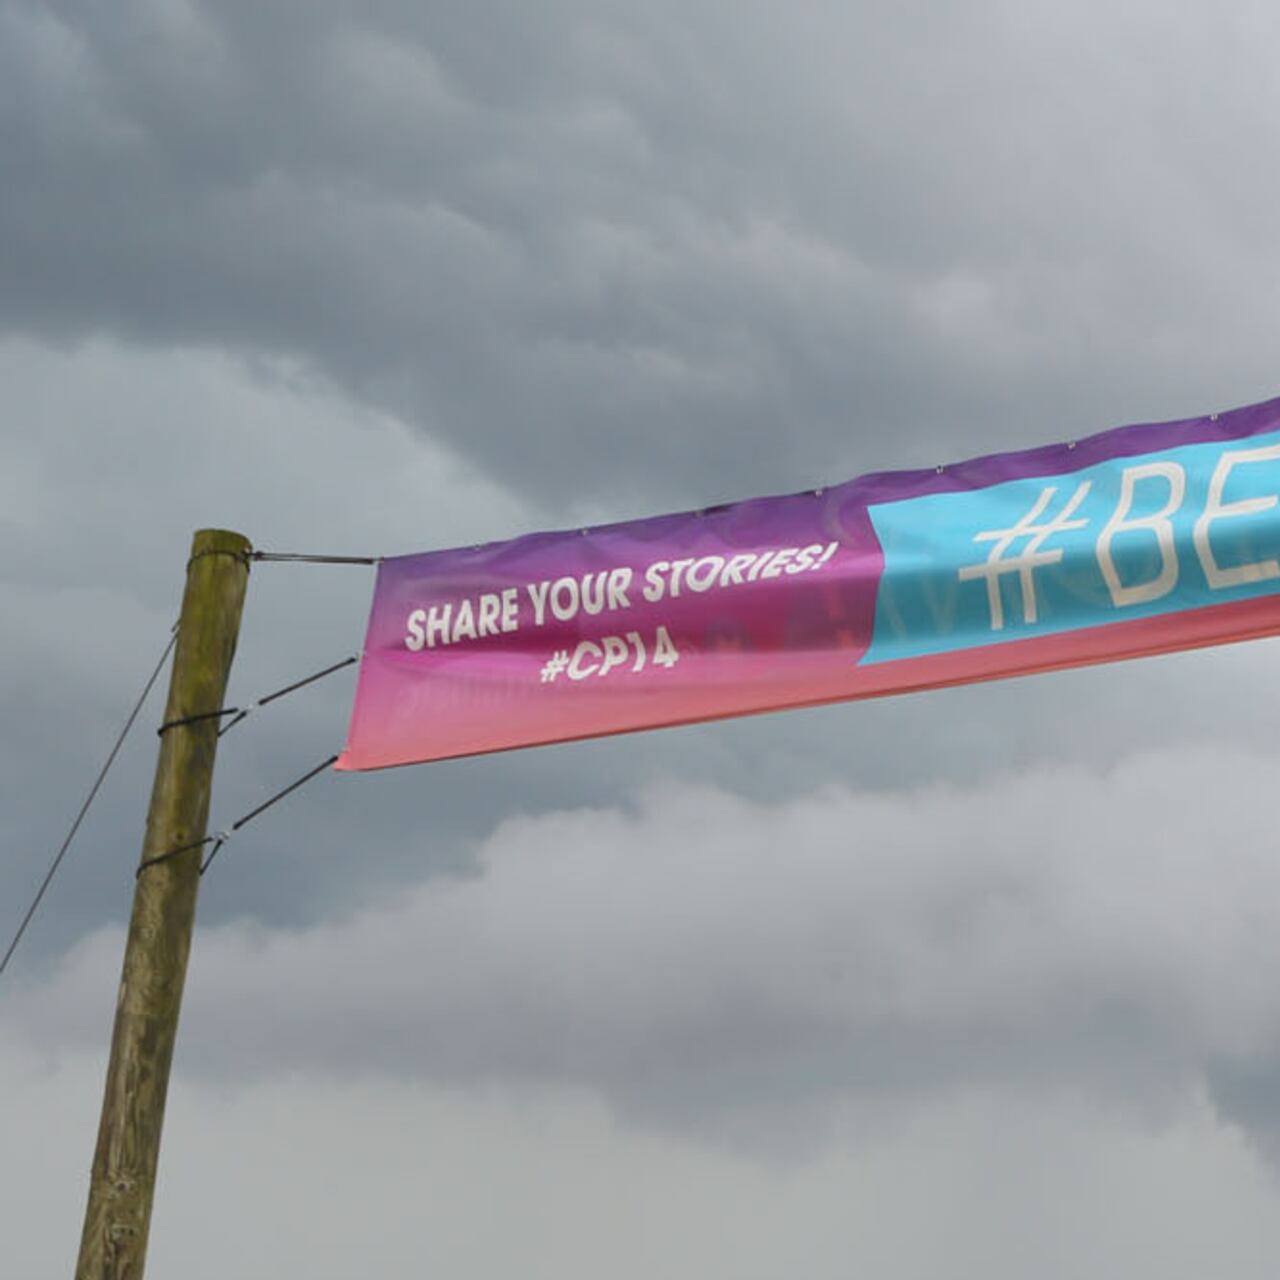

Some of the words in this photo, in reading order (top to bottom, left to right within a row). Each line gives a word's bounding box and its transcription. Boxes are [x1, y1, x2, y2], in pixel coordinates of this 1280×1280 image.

[404, 588, 518, 652] SHARE
[527, 567, 633, 626] YOUR
[642, 542, 839, 601] STORIES!
[540, 626, 680, 683] #CP14
